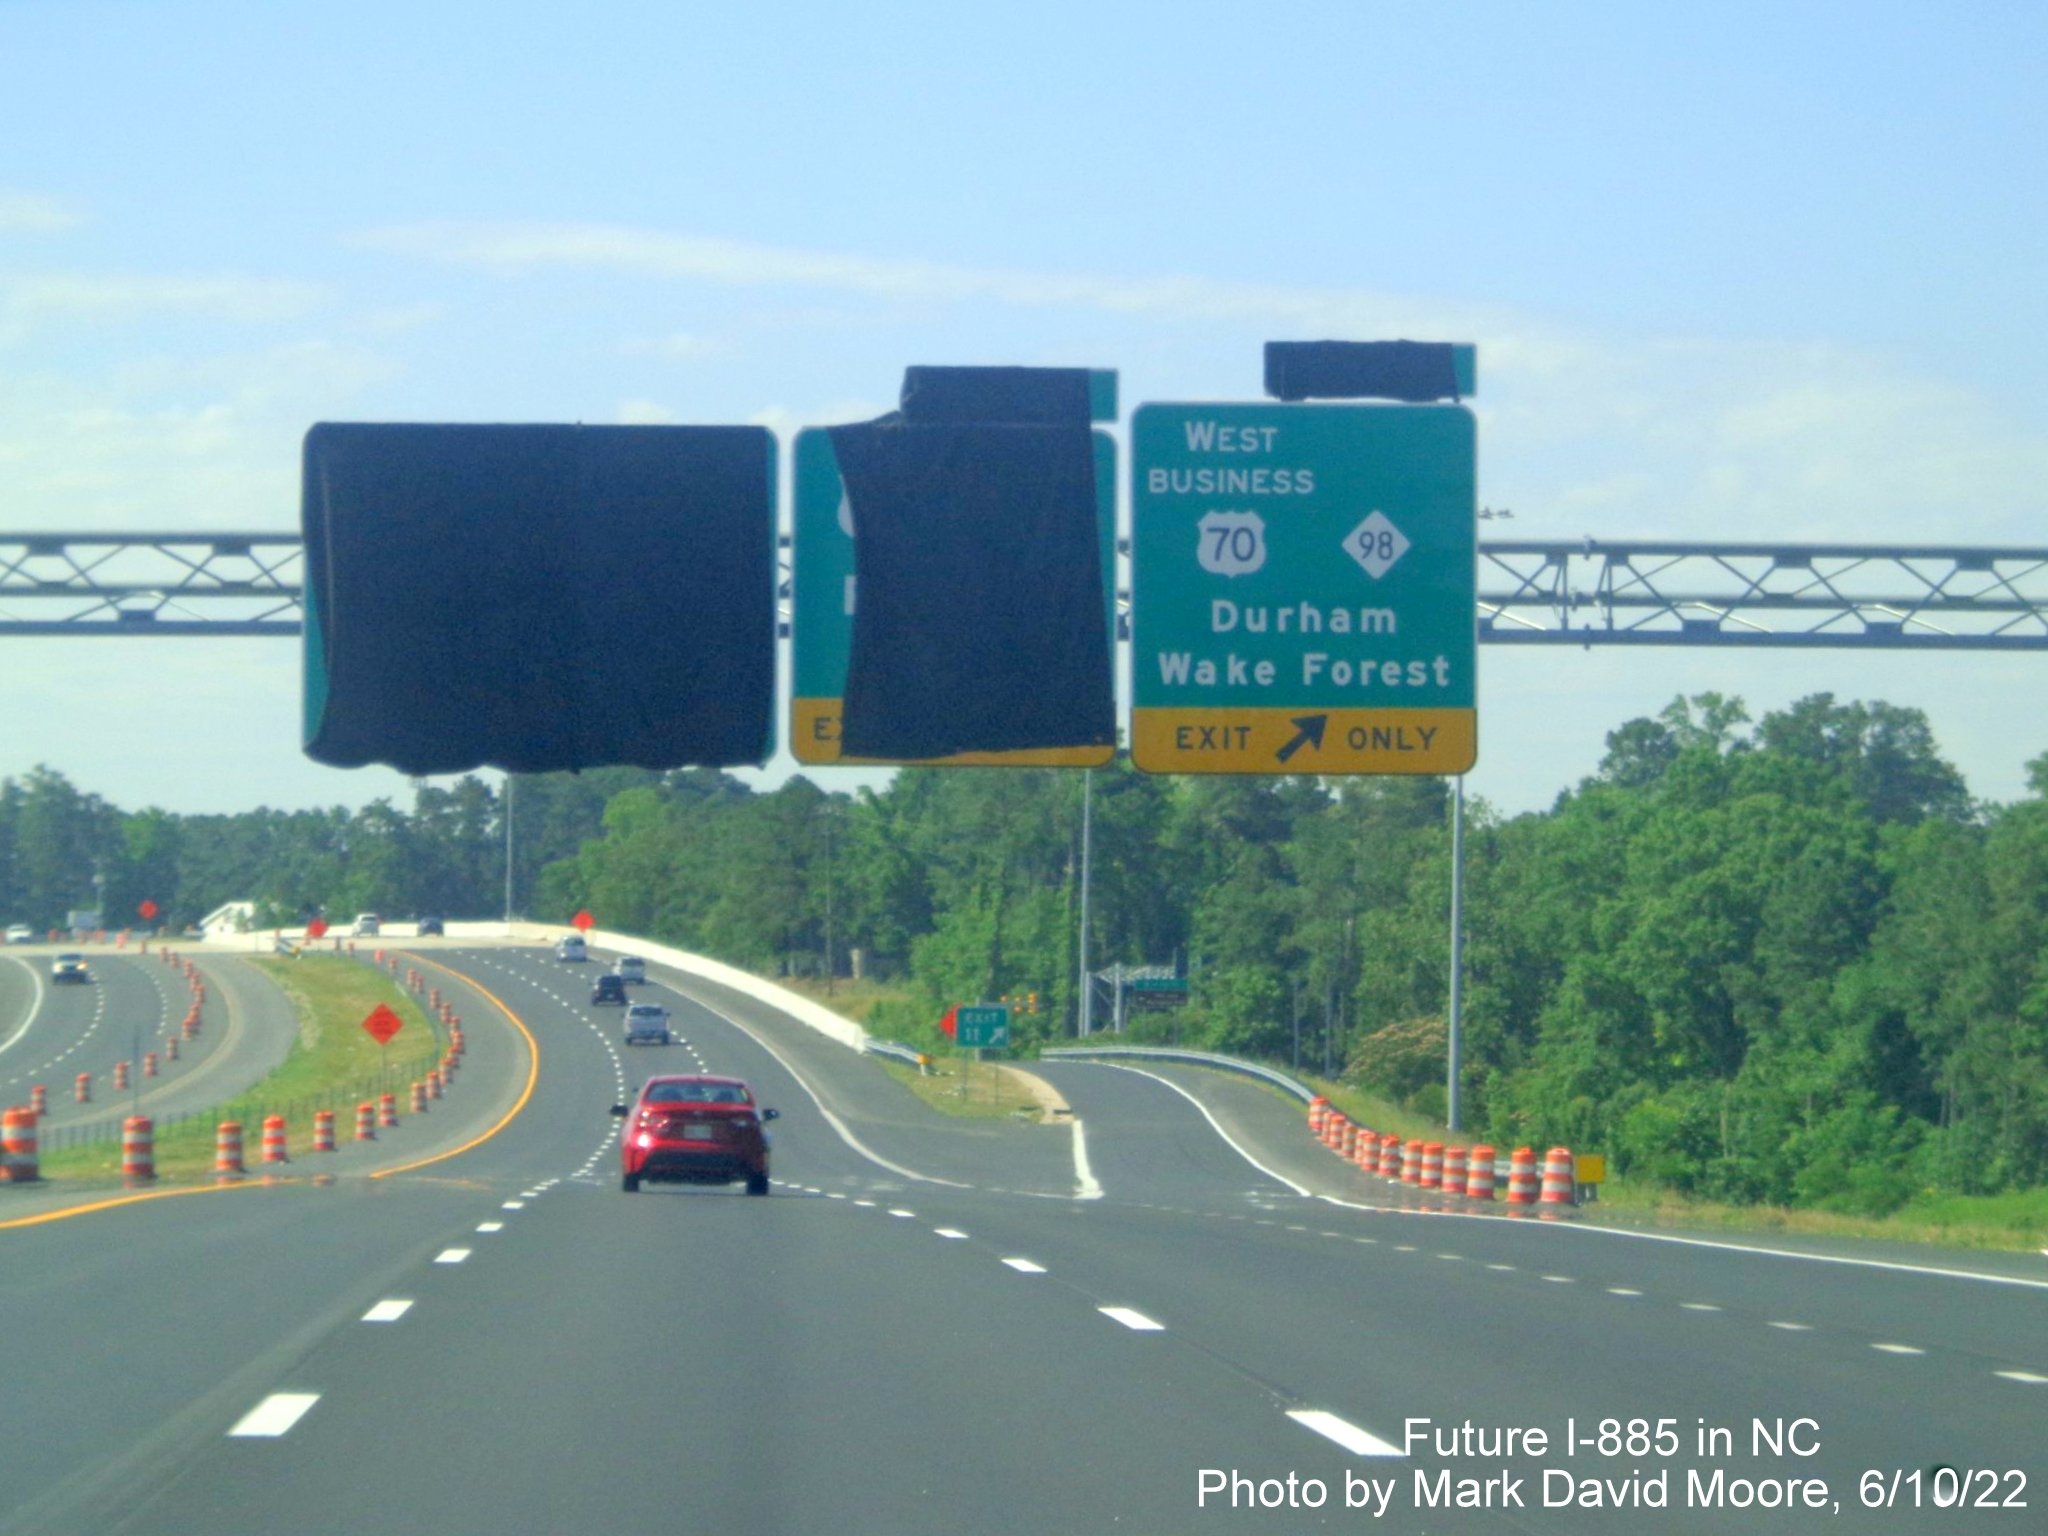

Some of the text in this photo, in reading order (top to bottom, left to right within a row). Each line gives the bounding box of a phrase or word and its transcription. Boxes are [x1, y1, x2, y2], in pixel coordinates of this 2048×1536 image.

[1185, 421, 1278, 452] WEST
[1149, 469, 1315, 494] BUSINESS
[1207, 527, 1256, 562] 70
[1358, 531, 1394, 561] 98
[1212, 600, 1397, 633] Durham
[1158, 652, 1450, 687] Wake Forest
[1176, 726, 1438, 751] EXIT ONLY
